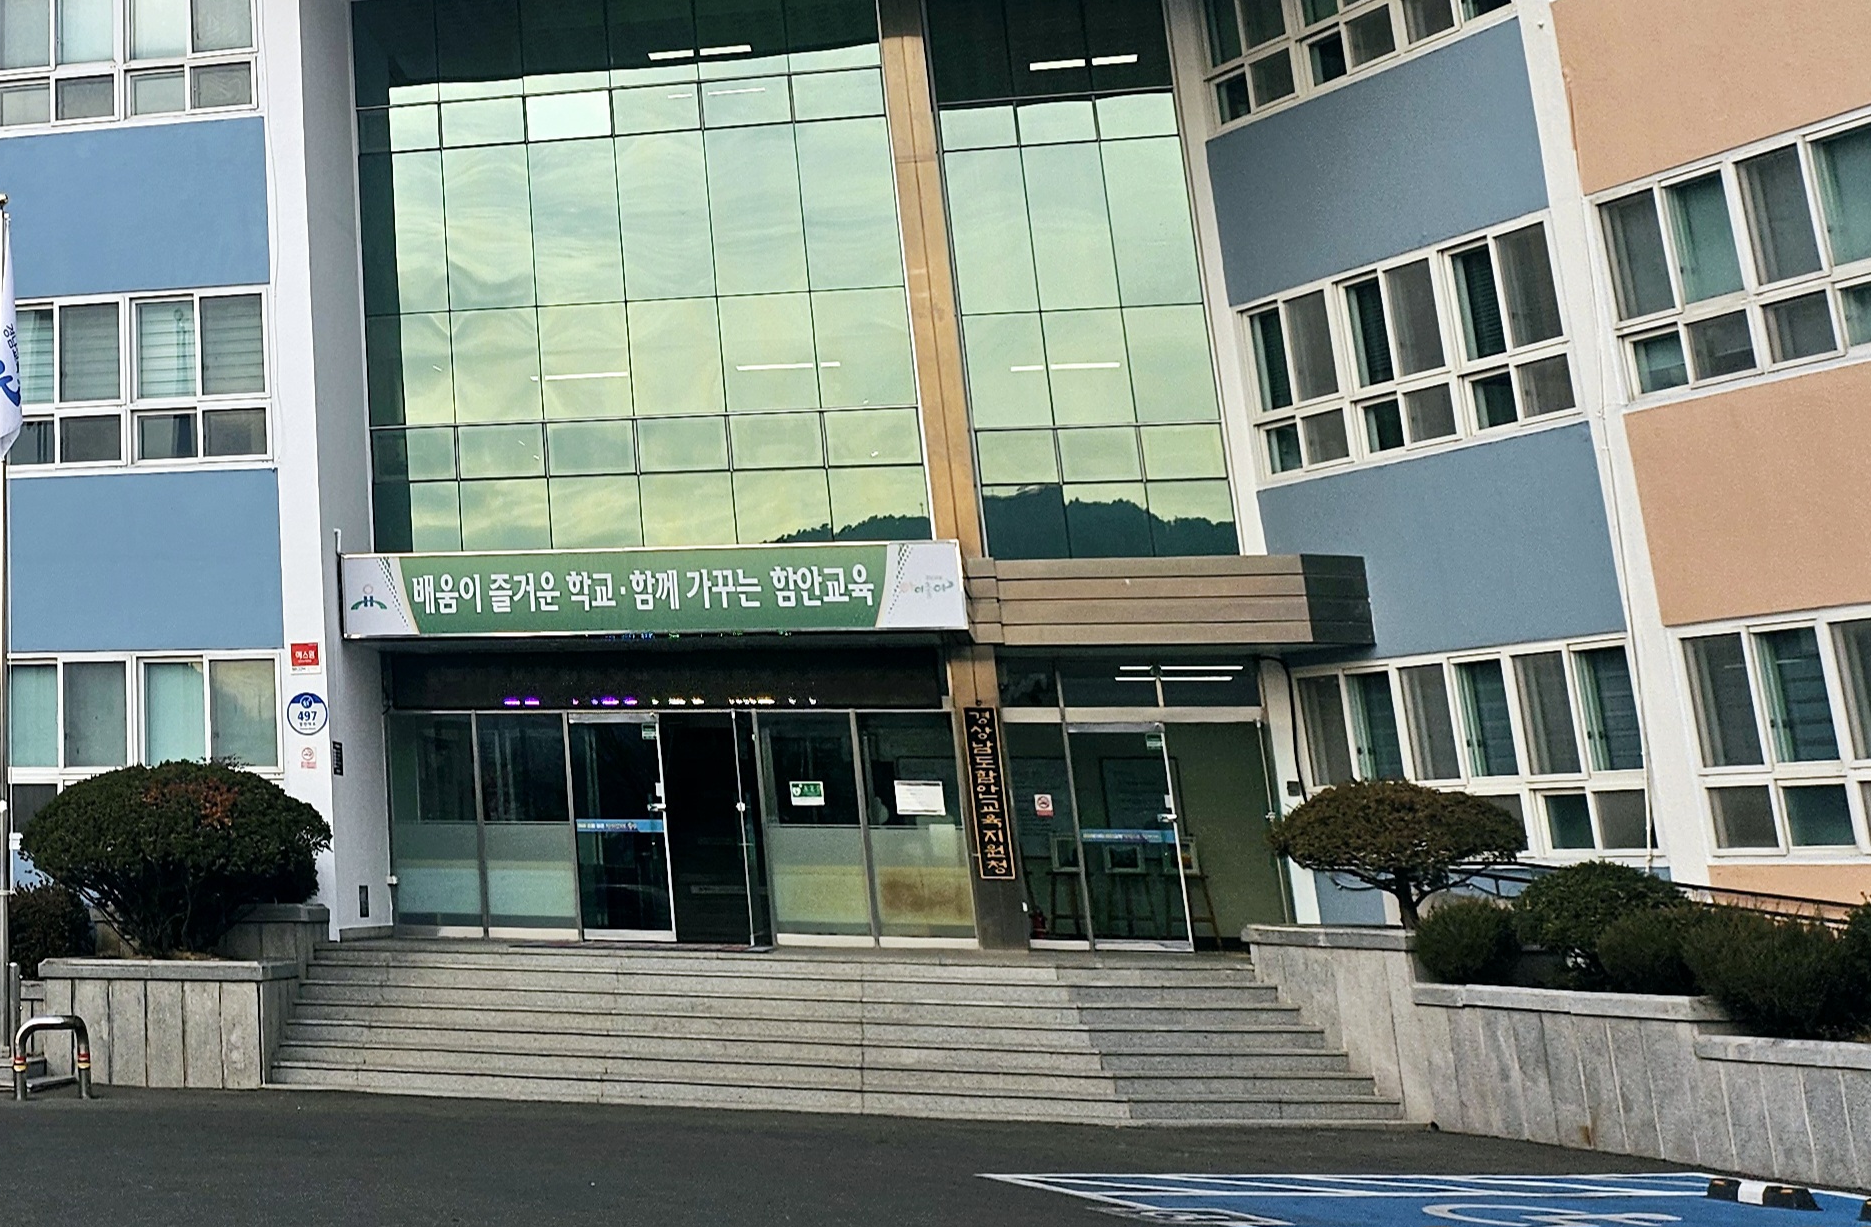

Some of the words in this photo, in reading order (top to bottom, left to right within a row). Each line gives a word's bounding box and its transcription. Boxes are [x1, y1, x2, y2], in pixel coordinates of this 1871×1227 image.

[411, 573, 482, 615] 배움이
[488, 571, 561, 614] 즐거운
[686, 568, 762, 610] 가꾸는
[769, 562, 875, 607] 함안교육
[297, 710, 318, 722] 497
[968, 710, 1008, 874] 경상남도함안교육지원청
